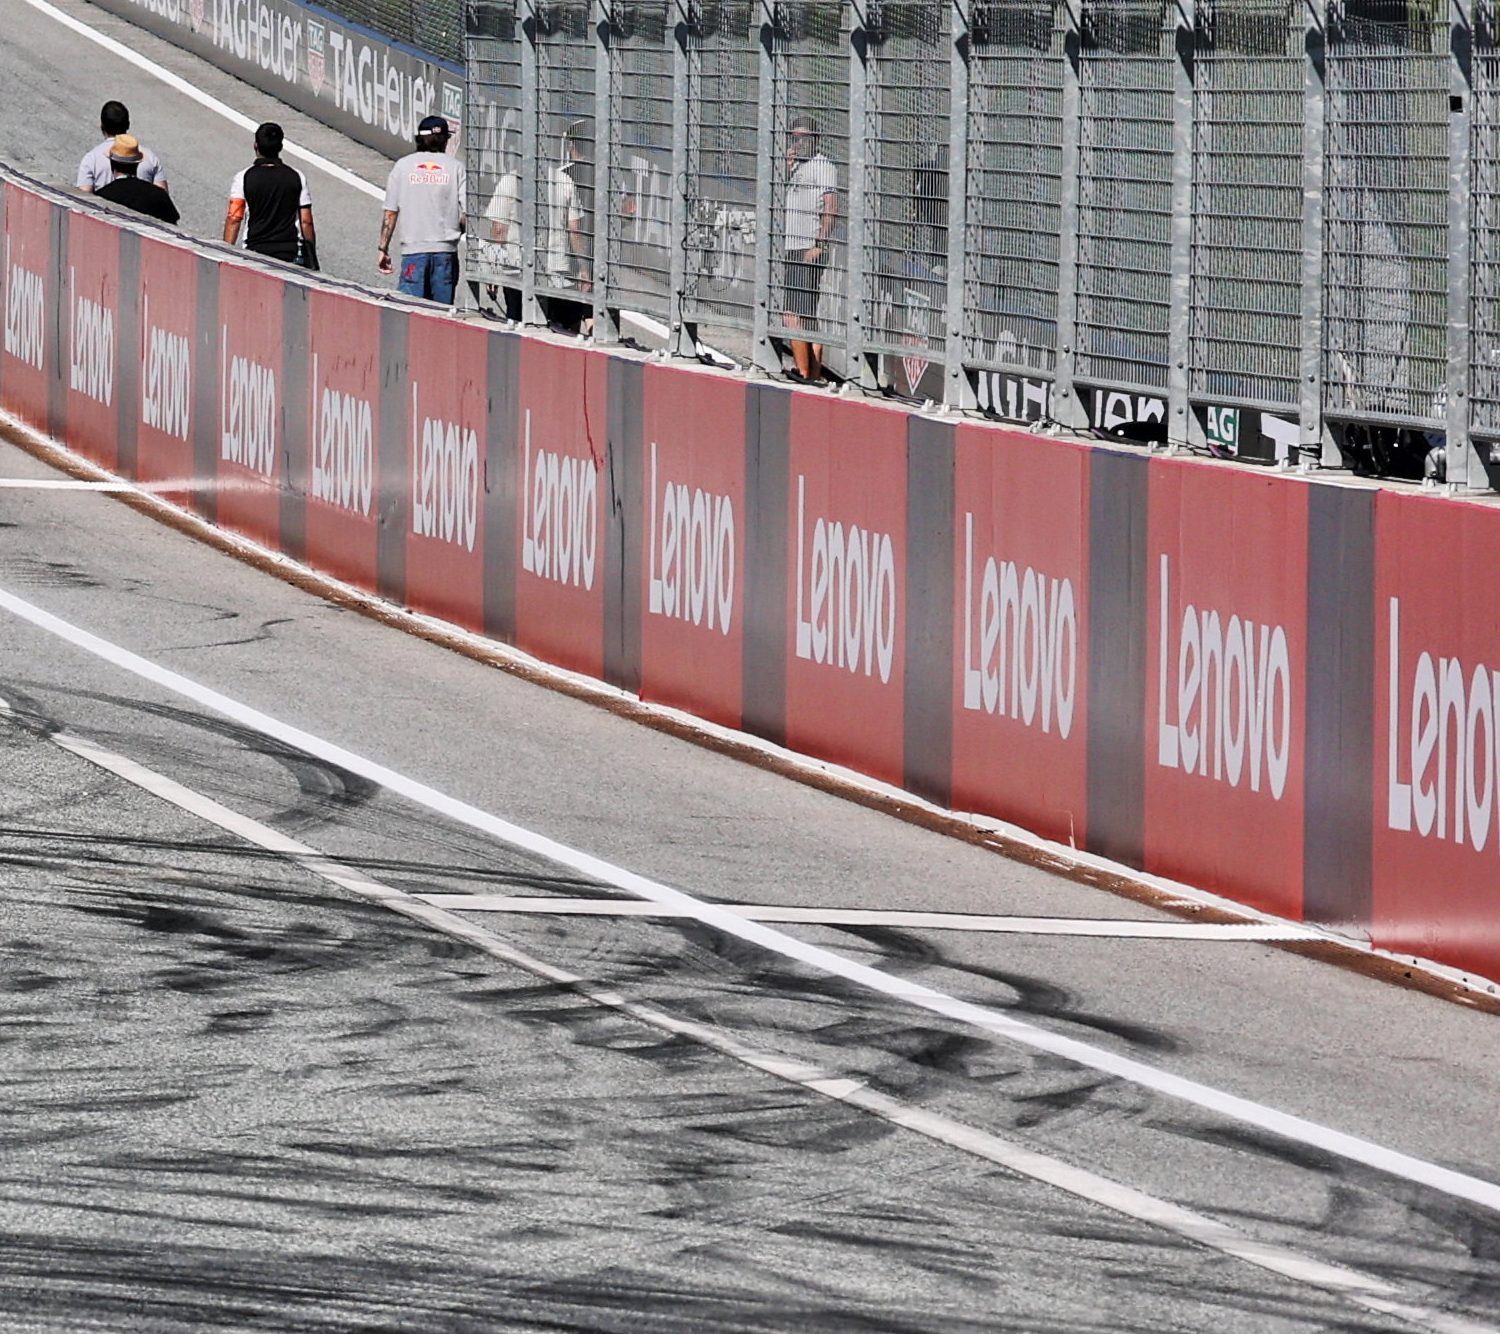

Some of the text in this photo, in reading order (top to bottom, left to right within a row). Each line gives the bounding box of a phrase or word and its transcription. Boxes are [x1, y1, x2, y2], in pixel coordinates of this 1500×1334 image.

[307, 22, 324, 52] TAG
[444, 86, 462, 118] TAG
[4, 234, 45, 372] Lenovo
[70, 265, 113, 408] Lenovo
[142, 293, 191, 443] Lenovo
[221, 323, 276, 478] Lenovo
[311, 352, 373, 517] Lenovo
[412, 380, 478, 553] Lenovo
[522, 408, 598, 592] Lenovo
[648, 441, 736, 636] Lenovo
[795, 474, 896, 685] Lenovo
[963, 511, 1077, 741] Lenovo
[1158, 553, 1292, 801] Lenovo
[1388, 596, 1500, 859] Leno
